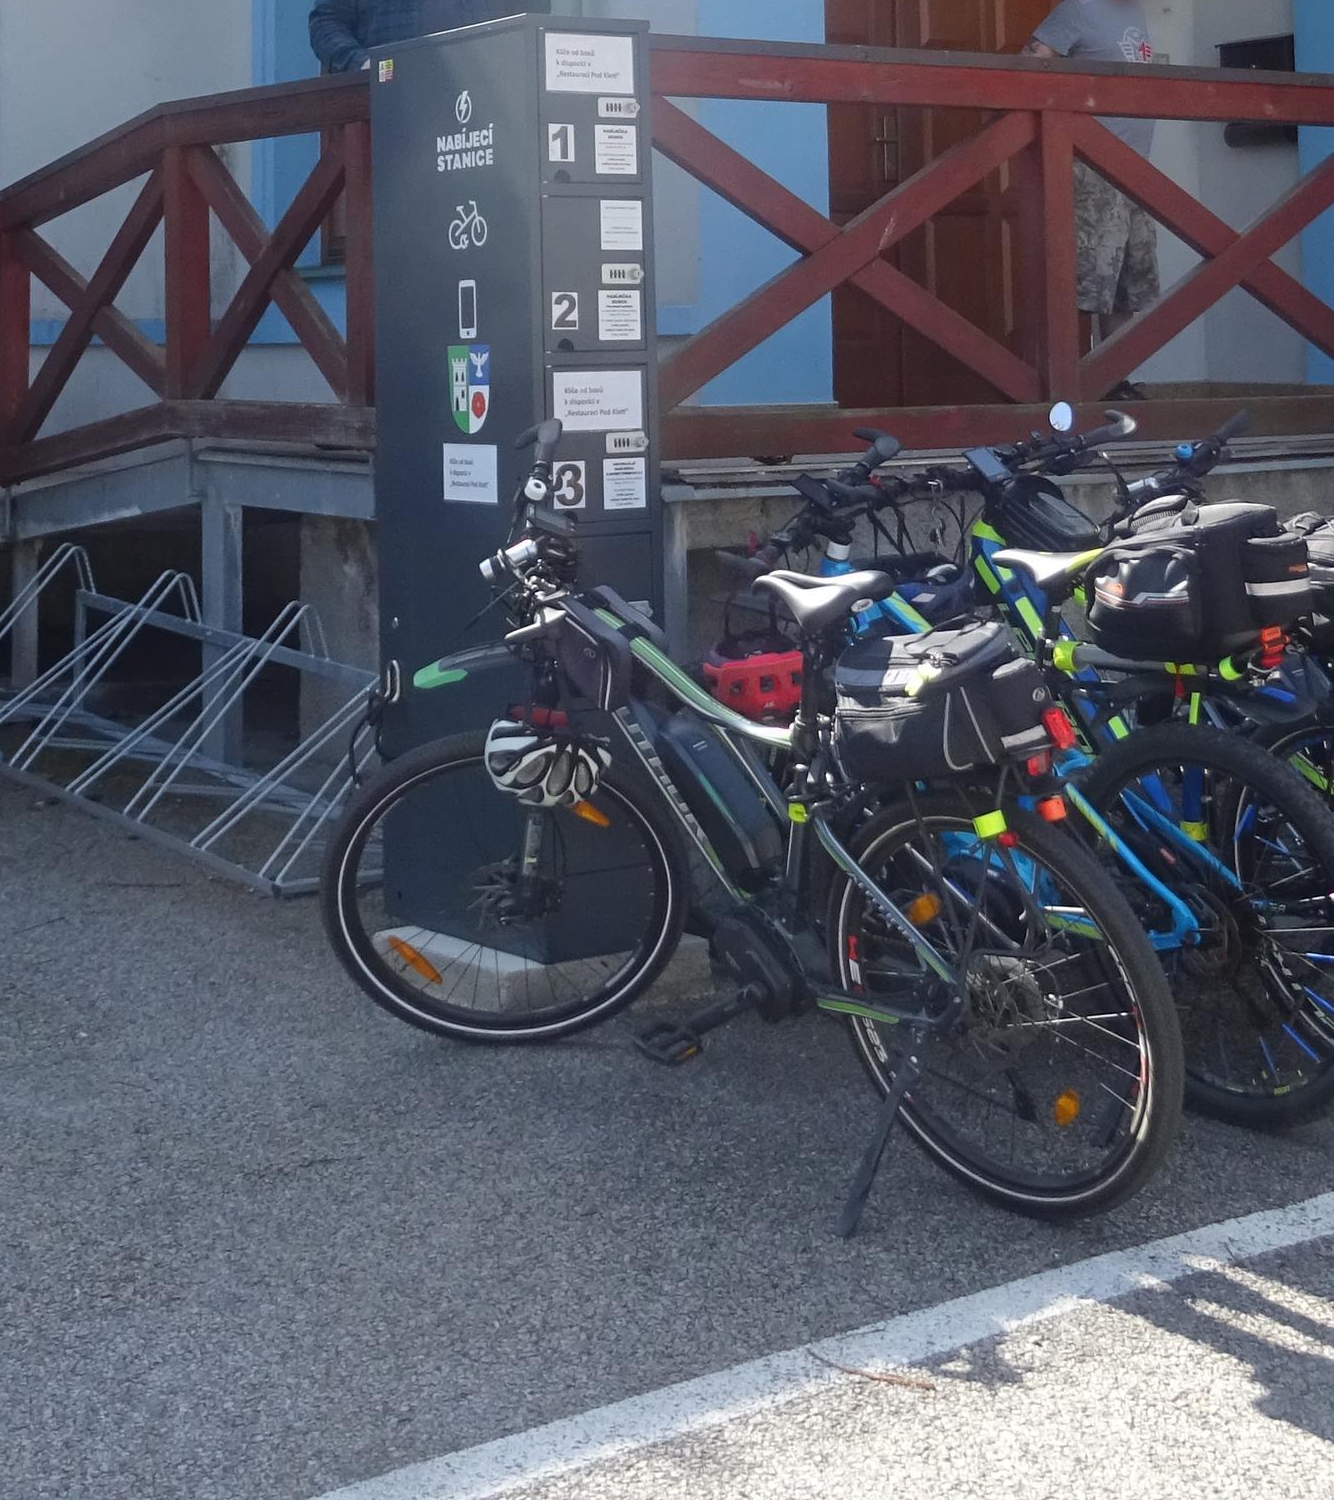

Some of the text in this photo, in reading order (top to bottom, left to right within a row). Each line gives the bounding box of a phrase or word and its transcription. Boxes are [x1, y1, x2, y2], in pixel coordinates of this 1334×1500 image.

[436, 123, 494, 152] NABÍJECÍ
[551, 125, 569, 160] 1
[437, 148, 494, 172] STANICE
[554, 293, 577, 328] 2
[555, 463, 584, 507] 3
